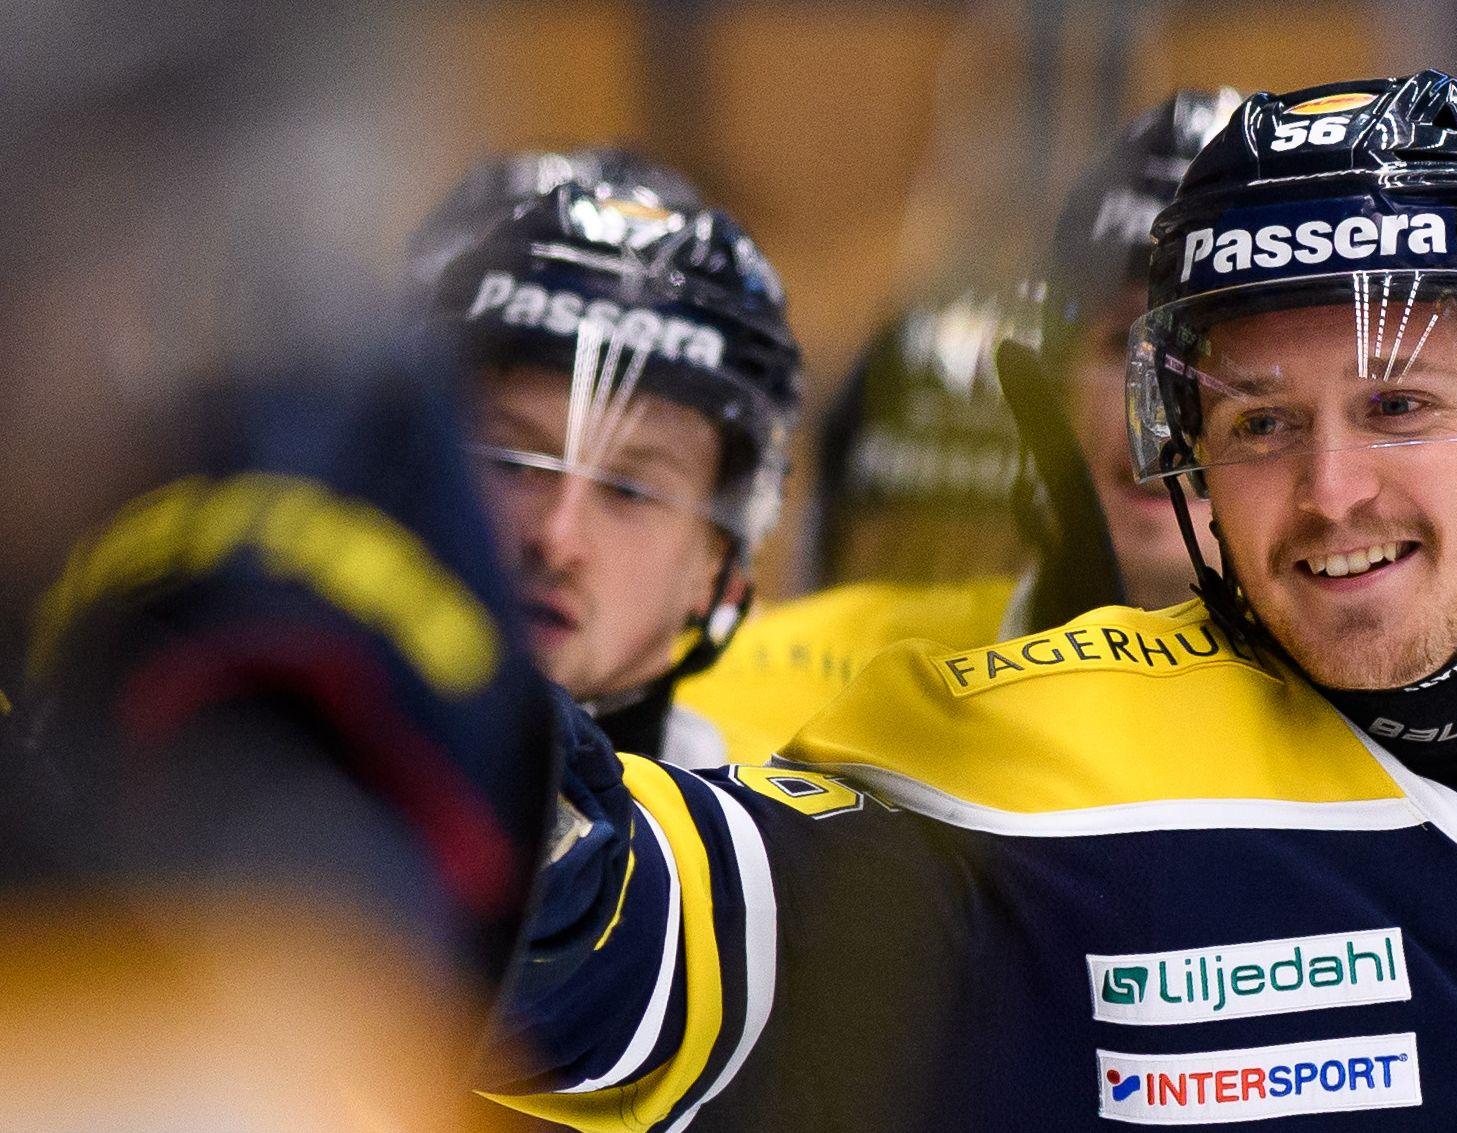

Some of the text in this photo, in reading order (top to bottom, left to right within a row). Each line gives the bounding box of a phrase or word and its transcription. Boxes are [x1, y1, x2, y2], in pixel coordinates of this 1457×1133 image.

[1270, 115, 1350, 152] 56
[1181, 213, 1447, 282] Passera
[945, 625, 1250, 688] FAGERHU
[1158, 937, 1396, 1011] Liljedahl
